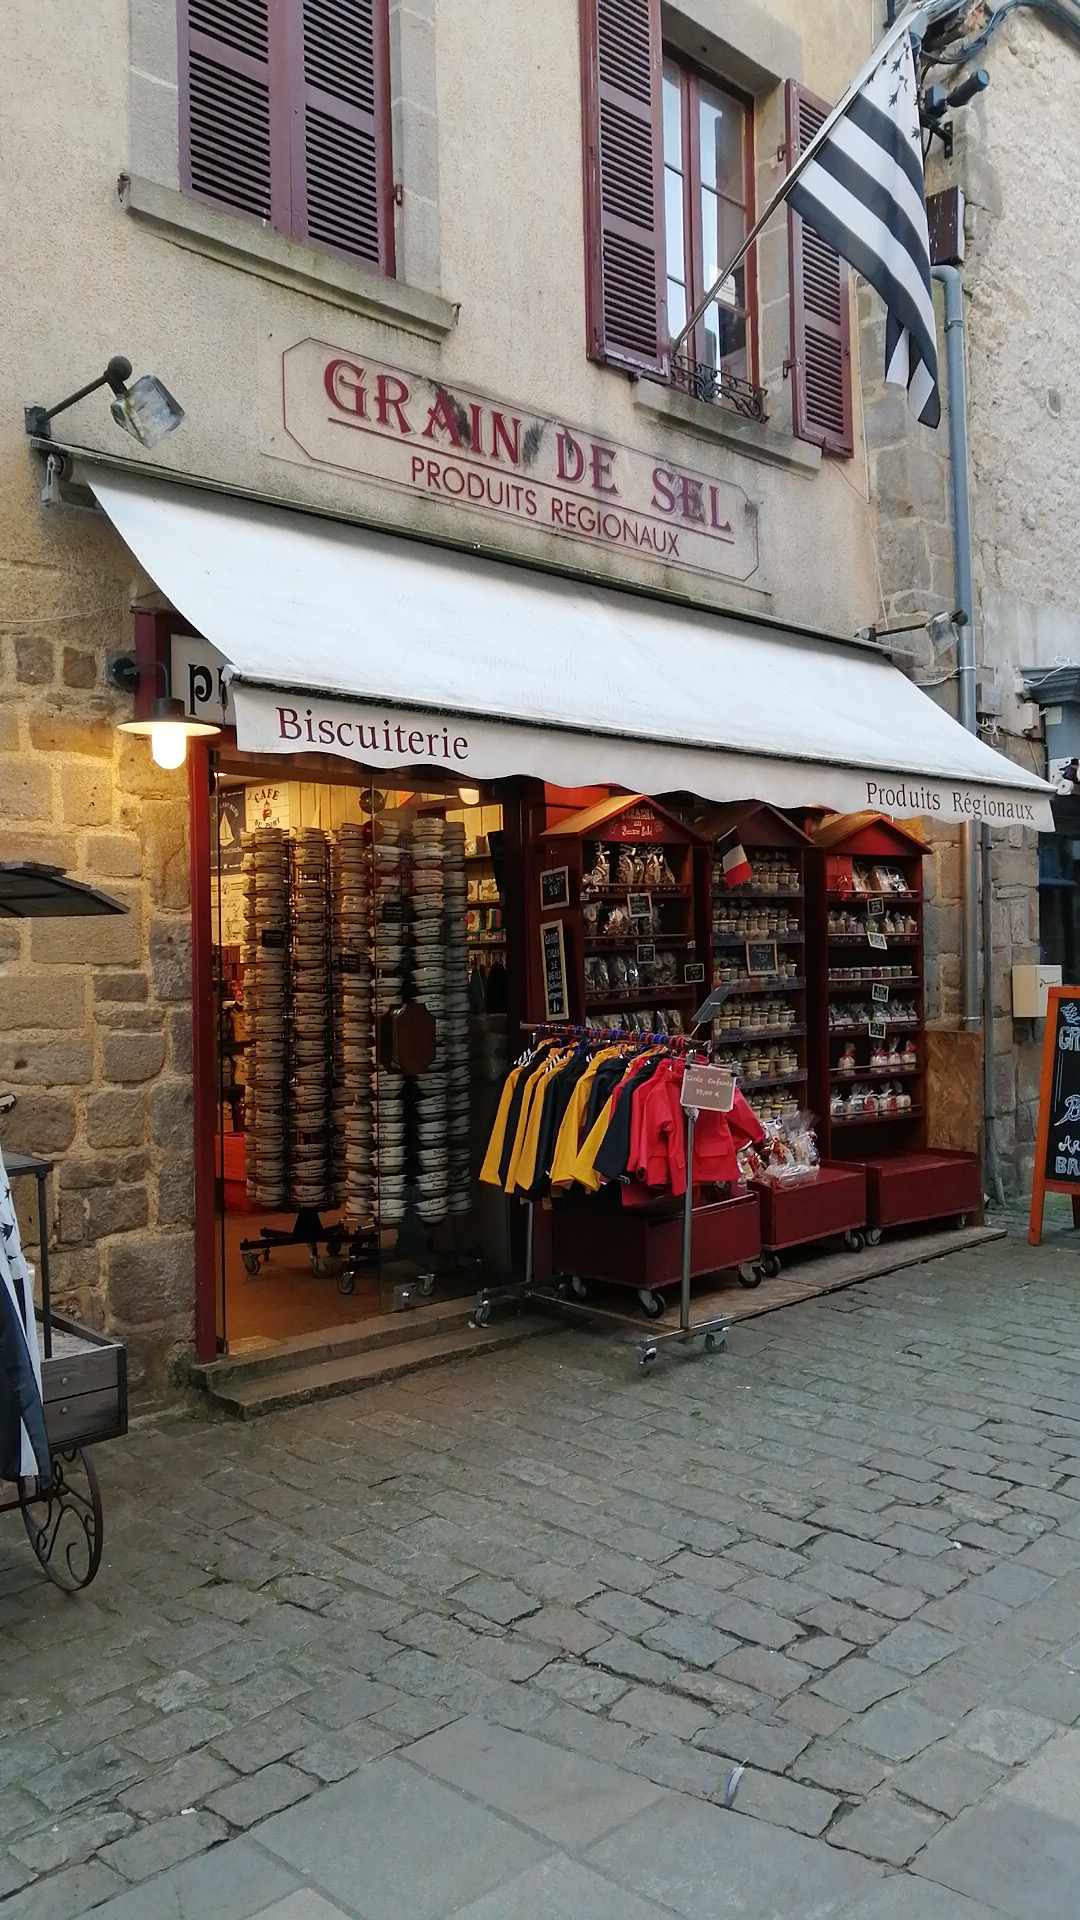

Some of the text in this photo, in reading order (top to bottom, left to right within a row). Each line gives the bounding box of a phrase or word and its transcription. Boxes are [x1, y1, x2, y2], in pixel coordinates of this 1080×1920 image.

[324, 359, 733, 533] GRAIN DE SEL
[411, 456, 681, 558] PRODUITS REGIONAUX
[275, 706, 469, 760] Biscuiterie
[866, 782, 1036, 822] Produits Régionaux
